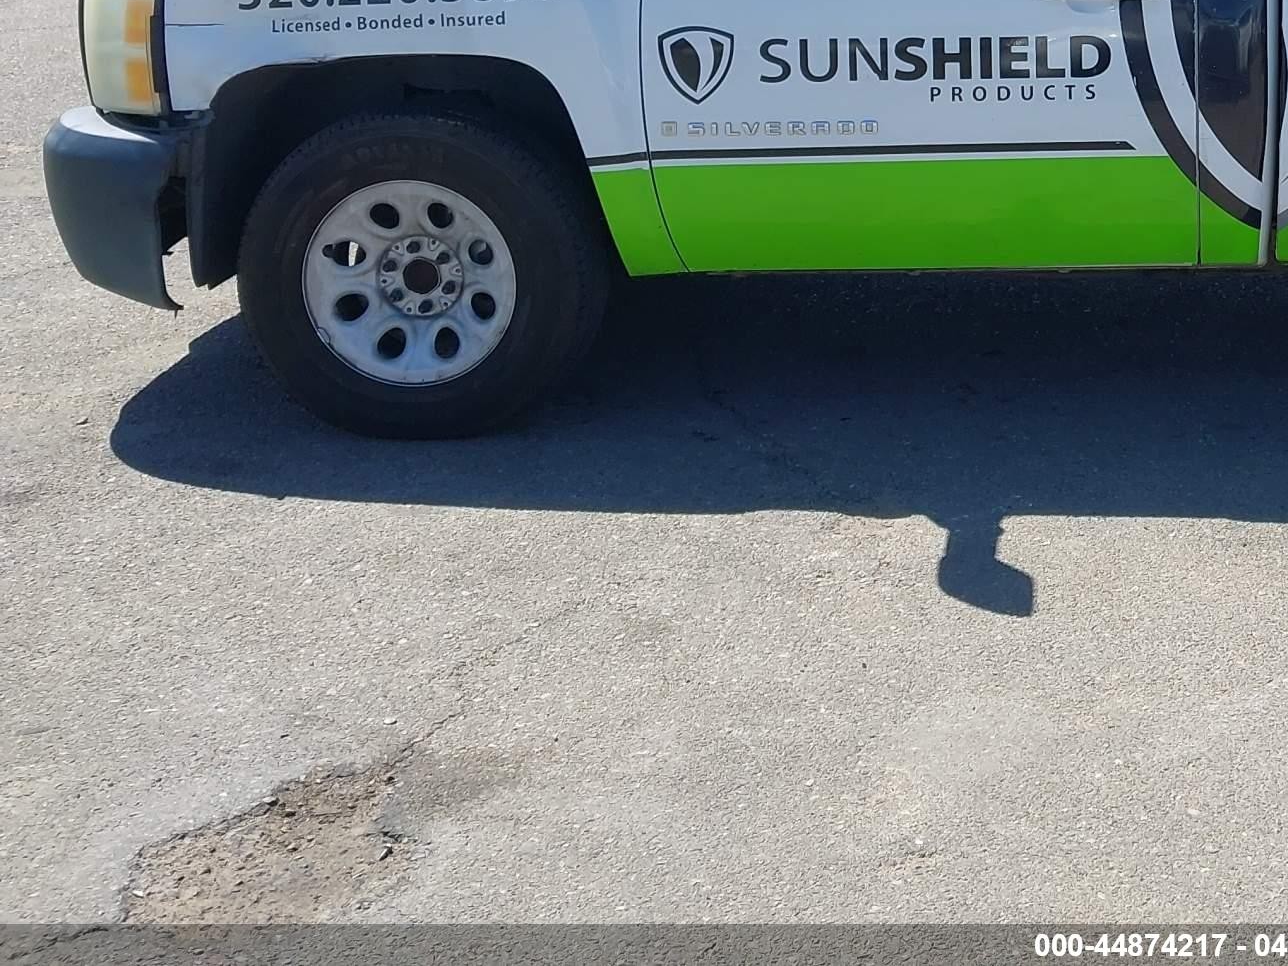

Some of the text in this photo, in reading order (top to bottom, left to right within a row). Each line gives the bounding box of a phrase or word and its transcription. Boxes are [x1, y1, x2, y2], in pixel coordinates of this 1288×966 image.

[272, 11, 506, 33] Licensed Bonded Insured
[759, 35, 1111, 83] SUNSHIELD
[930, 84, 1097, 102] PRODUCTS
[687, 119, 879, 137] SILVERADO
